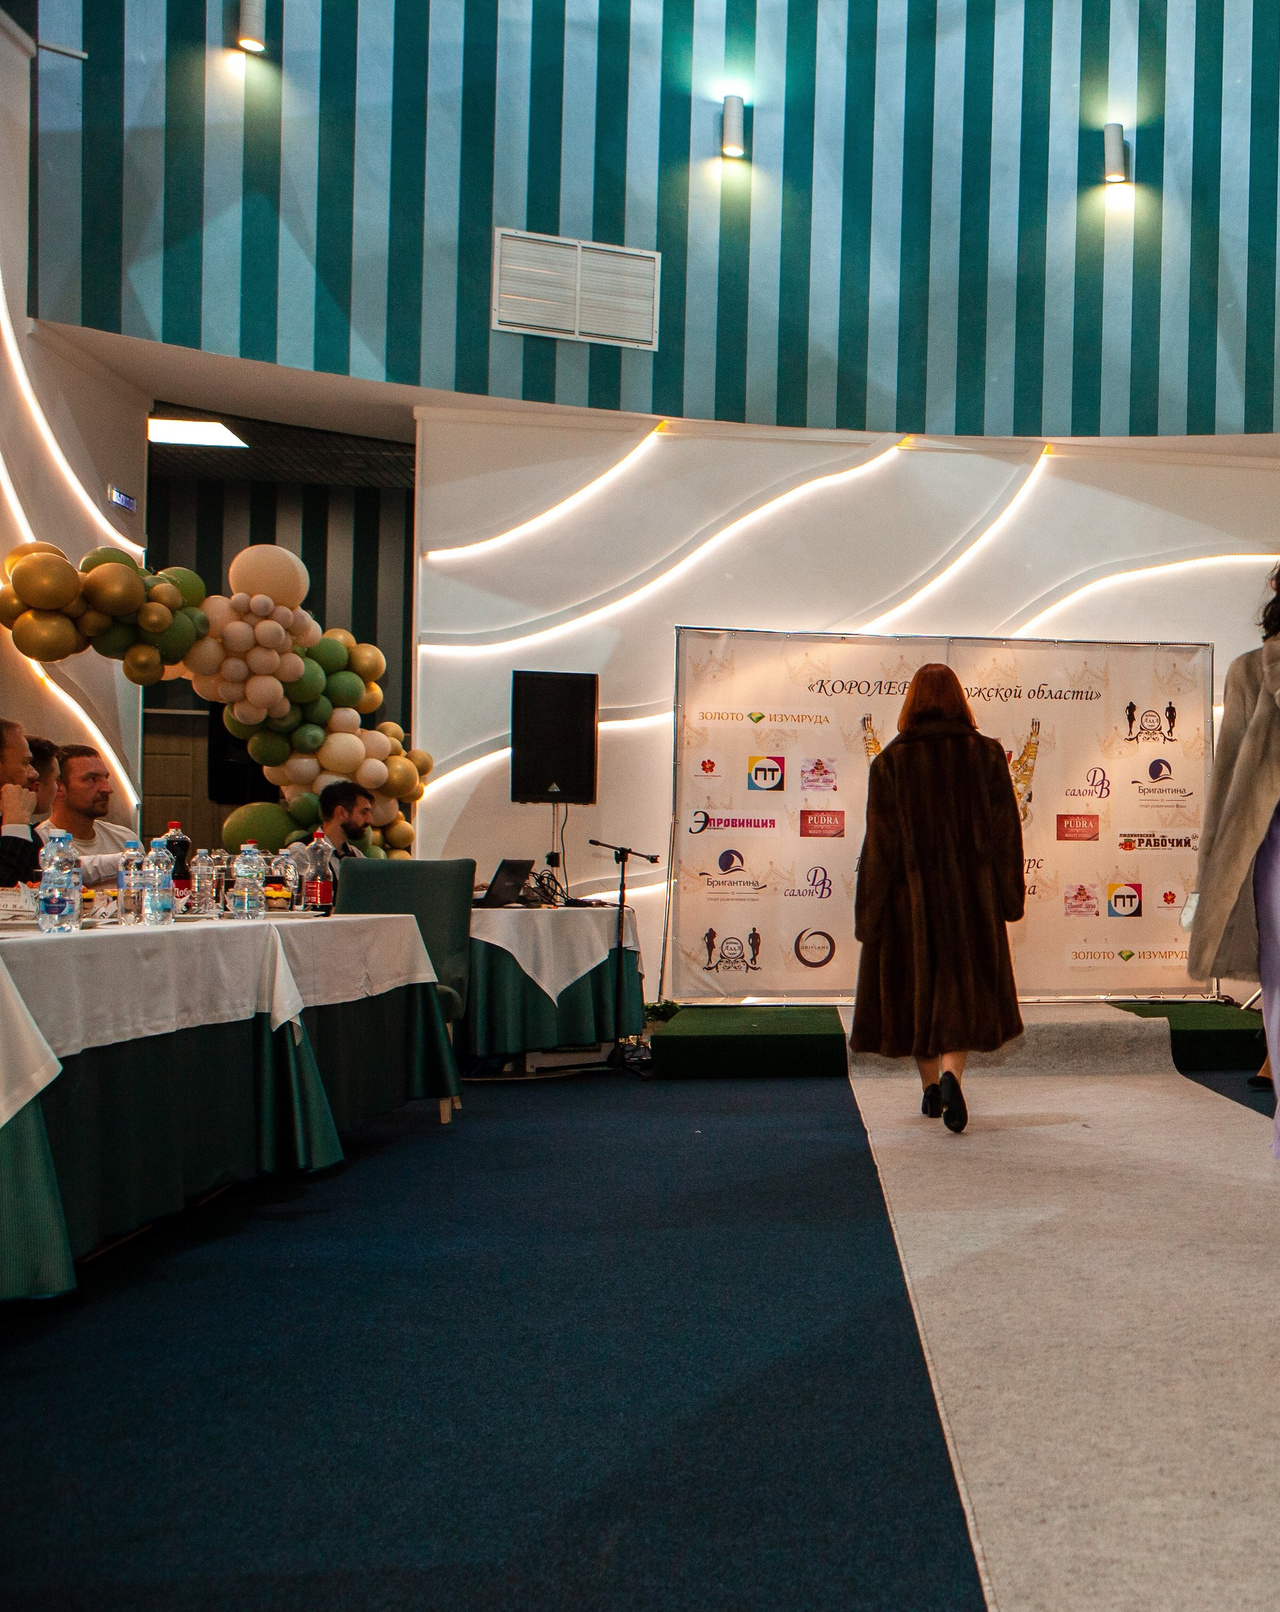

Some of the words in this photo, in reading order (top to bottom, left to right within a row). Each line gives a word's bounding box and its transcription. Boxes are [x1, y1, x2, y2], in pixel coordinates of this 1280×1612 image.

[807, 679, 911, 697] «КОРОЛЕВ
[964, 685, 1022, 702] ужской
[1027, 683, 1102, 701] области»
[698, 711, 744, 722] ЗОЛОТО
[769, 713, 830, 725] ИЗУМРУДА
[754, 767, 780, 781] ПТ
[1065, 787, 1095, 797] салон
[1138, 786, 1187, 796] Бригантина
[708, 818, 776, 828] ПРОВИНЦИЯ
[807, 816, 839, 825] PUDRA
[1064, 820, 1093, 828] PUDRA
[1137, 836, 1191, 848] РАБОЧИЙ
[706, 878, 759, 888] Бригантина
[784, 887, 815, 897] салон
[1114, 894, 1137, 908] ПТ
[1071, 951, 1115, 960] ЗОЛОТО
[1138, 950, 1188, 961] ИЗУМРУД
